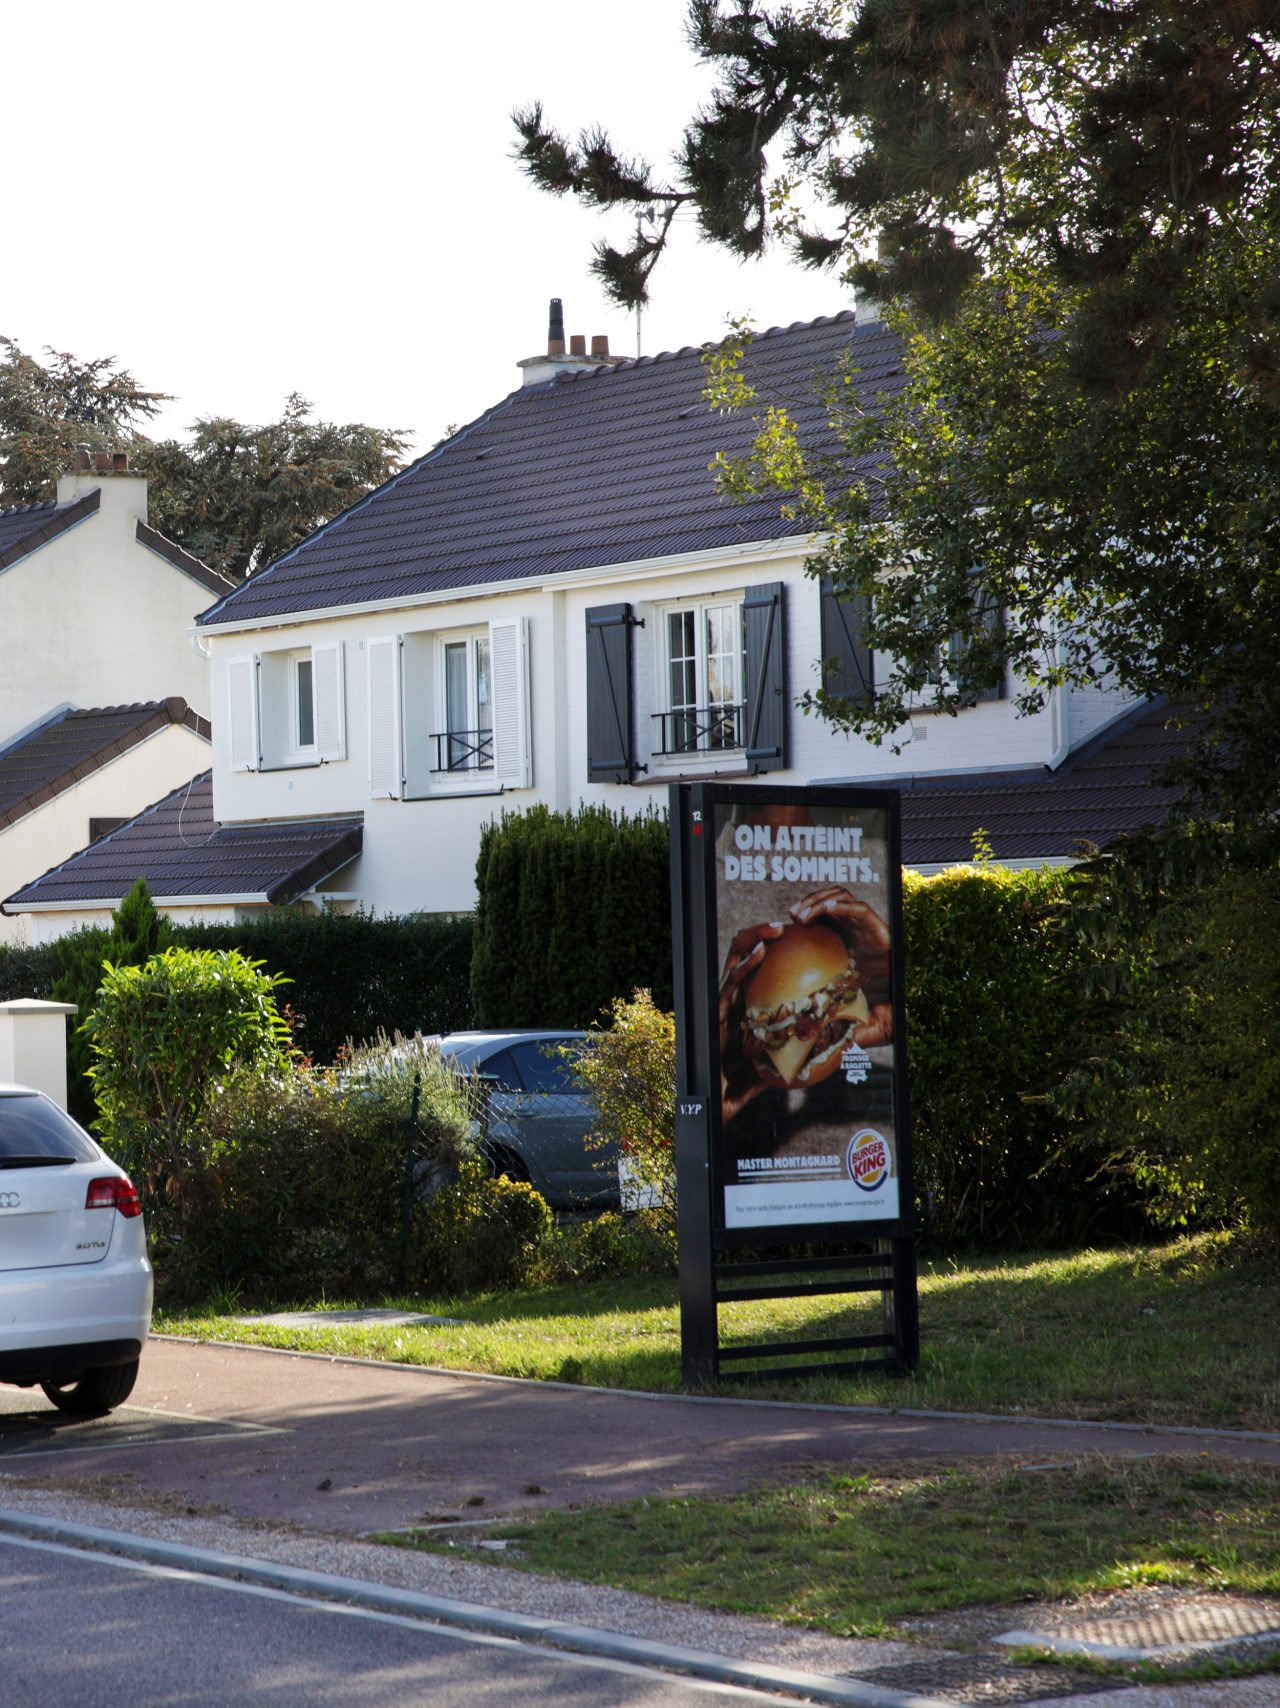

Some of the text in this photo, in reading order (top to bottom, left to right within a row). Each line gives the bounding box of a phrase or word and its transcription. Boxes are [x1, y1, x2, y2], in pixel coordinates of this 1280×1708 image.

[692, 810, 702, 822] 12
[735, 824, 863, 852] ON ATTEINT
[724, 855, 880, 883] DES SOMMETS.
[737, 1155, 840, 1170] MASTER MONTAGNARD
[852, 1141, 884, 1165] BURGER
[853, 1152, 887, 1179] KING
